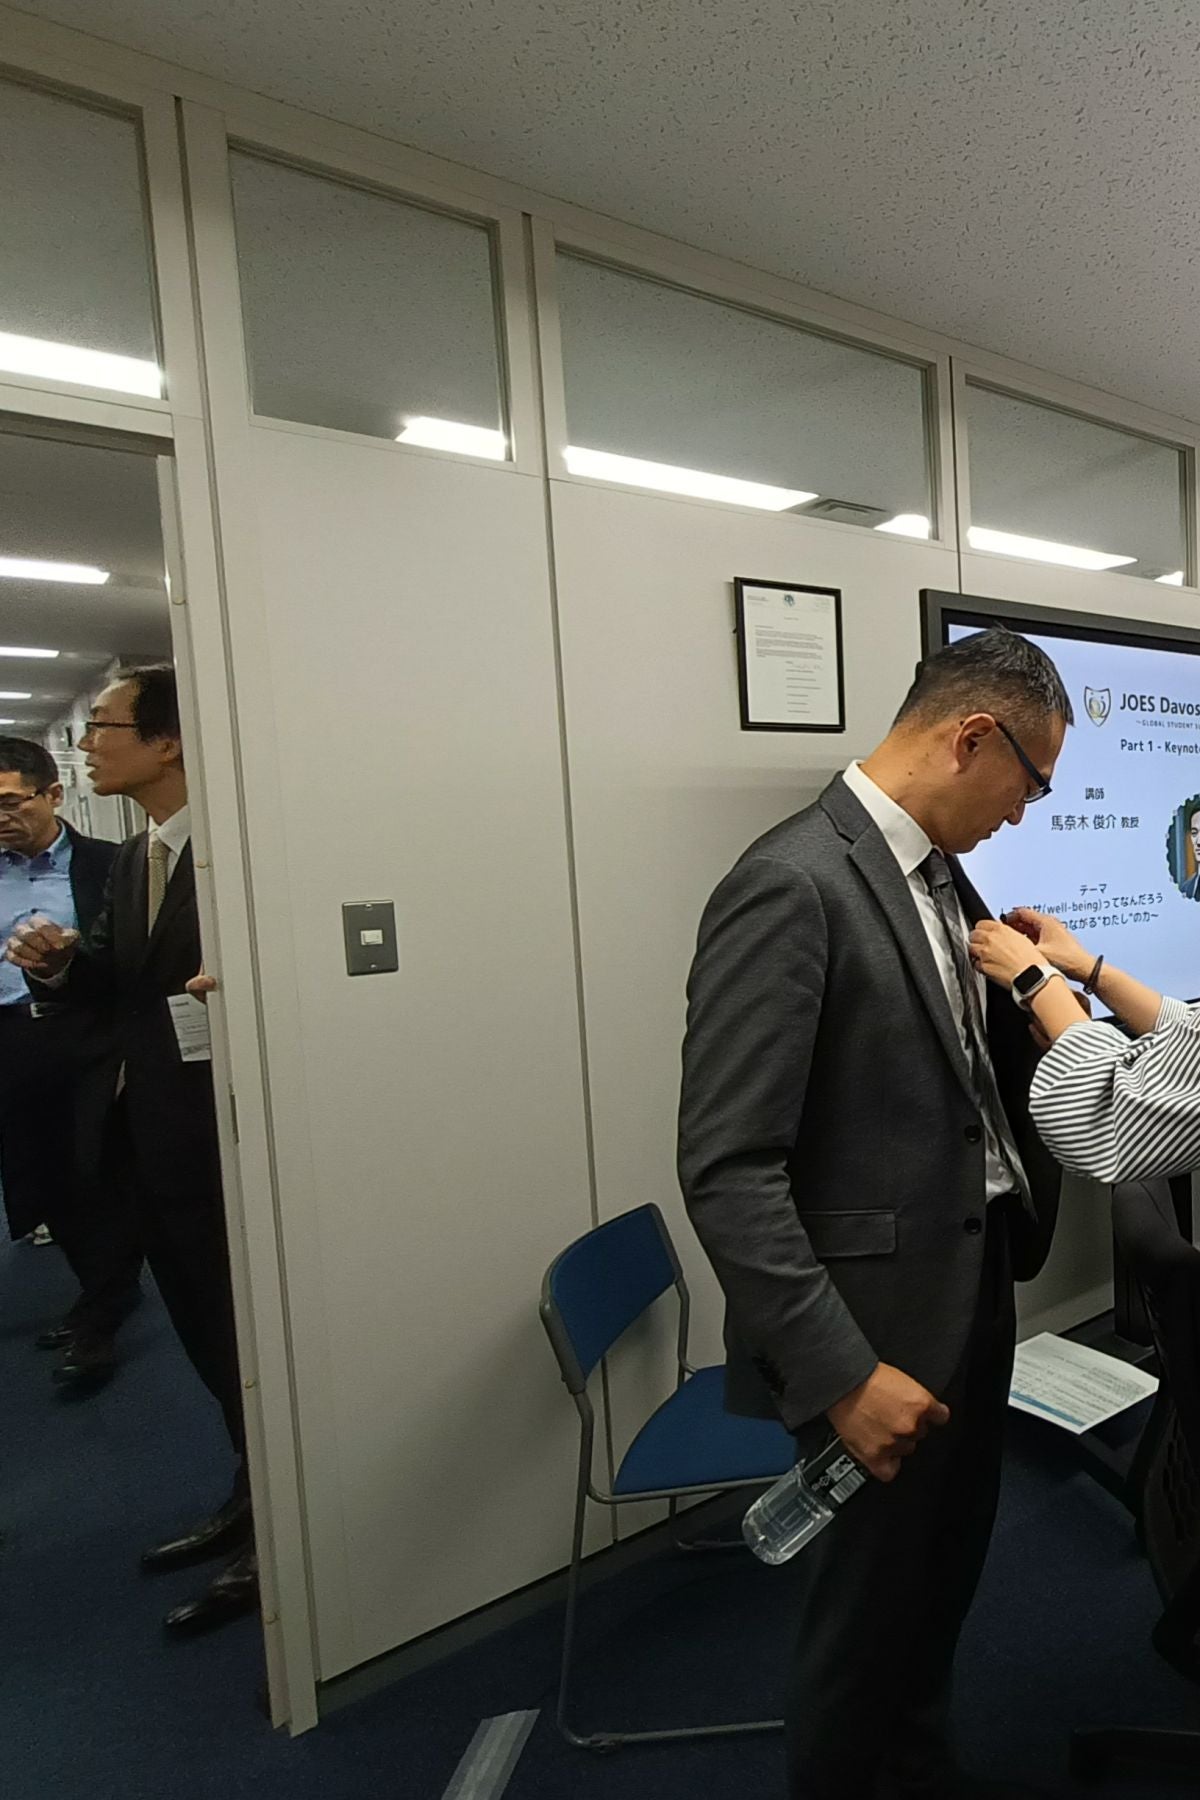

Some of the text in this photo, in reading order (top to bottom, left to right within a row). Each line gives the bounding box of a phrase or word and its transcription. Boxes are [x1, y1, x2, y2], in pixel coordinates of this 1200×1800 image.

[1119, 693, 1156, 713] JOES
[1160, 696, 1200, 717] Davos
[1167, 721, 1193, 730] STUDENT
[1120, 738, 1144, 752] Part
[1148, 740, 1153, 752] 1
[1085, 787, 1105, 800] 講師
[1051, 814, 1139, 831] 馬奈木 俊介 教授
[1080, 883, 1107, 896] テーマ
